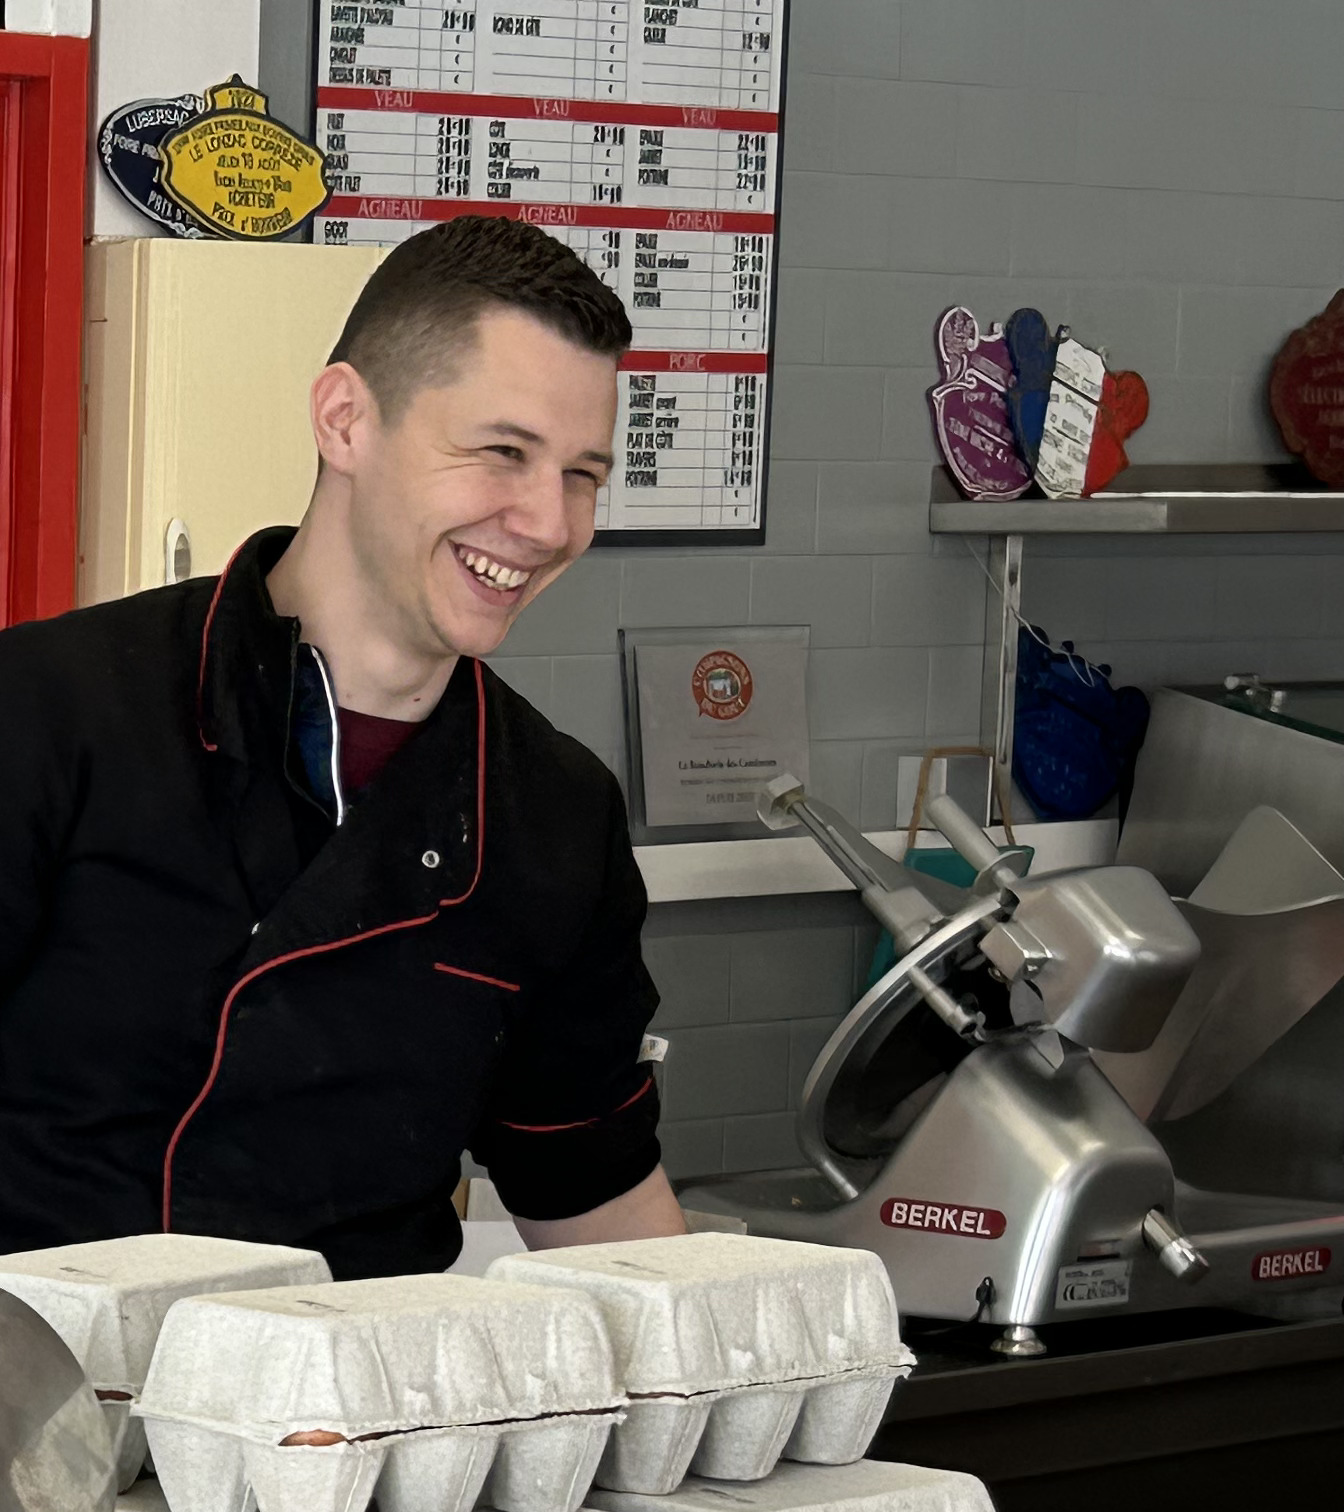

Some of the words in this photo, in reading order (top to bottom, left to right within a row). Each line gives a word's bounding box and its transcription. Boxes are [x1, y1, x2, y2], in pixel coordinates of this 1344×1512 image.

[374, 91, 413, 108] VEAU
[534, 99, 570, 117] VEAU
[682, 107, 717, 125] VEAU
[358, 200, 423, 219] AGNEAU
[517, 205, 577, 224] AGNEAU
[666, 212, 723, 231] AGNEAU
[669, 353, 706, 371] PORC
[891, 1202, 992, 1236] BERKEL
[1258, 1250, 1324, 1279] BERKEL
